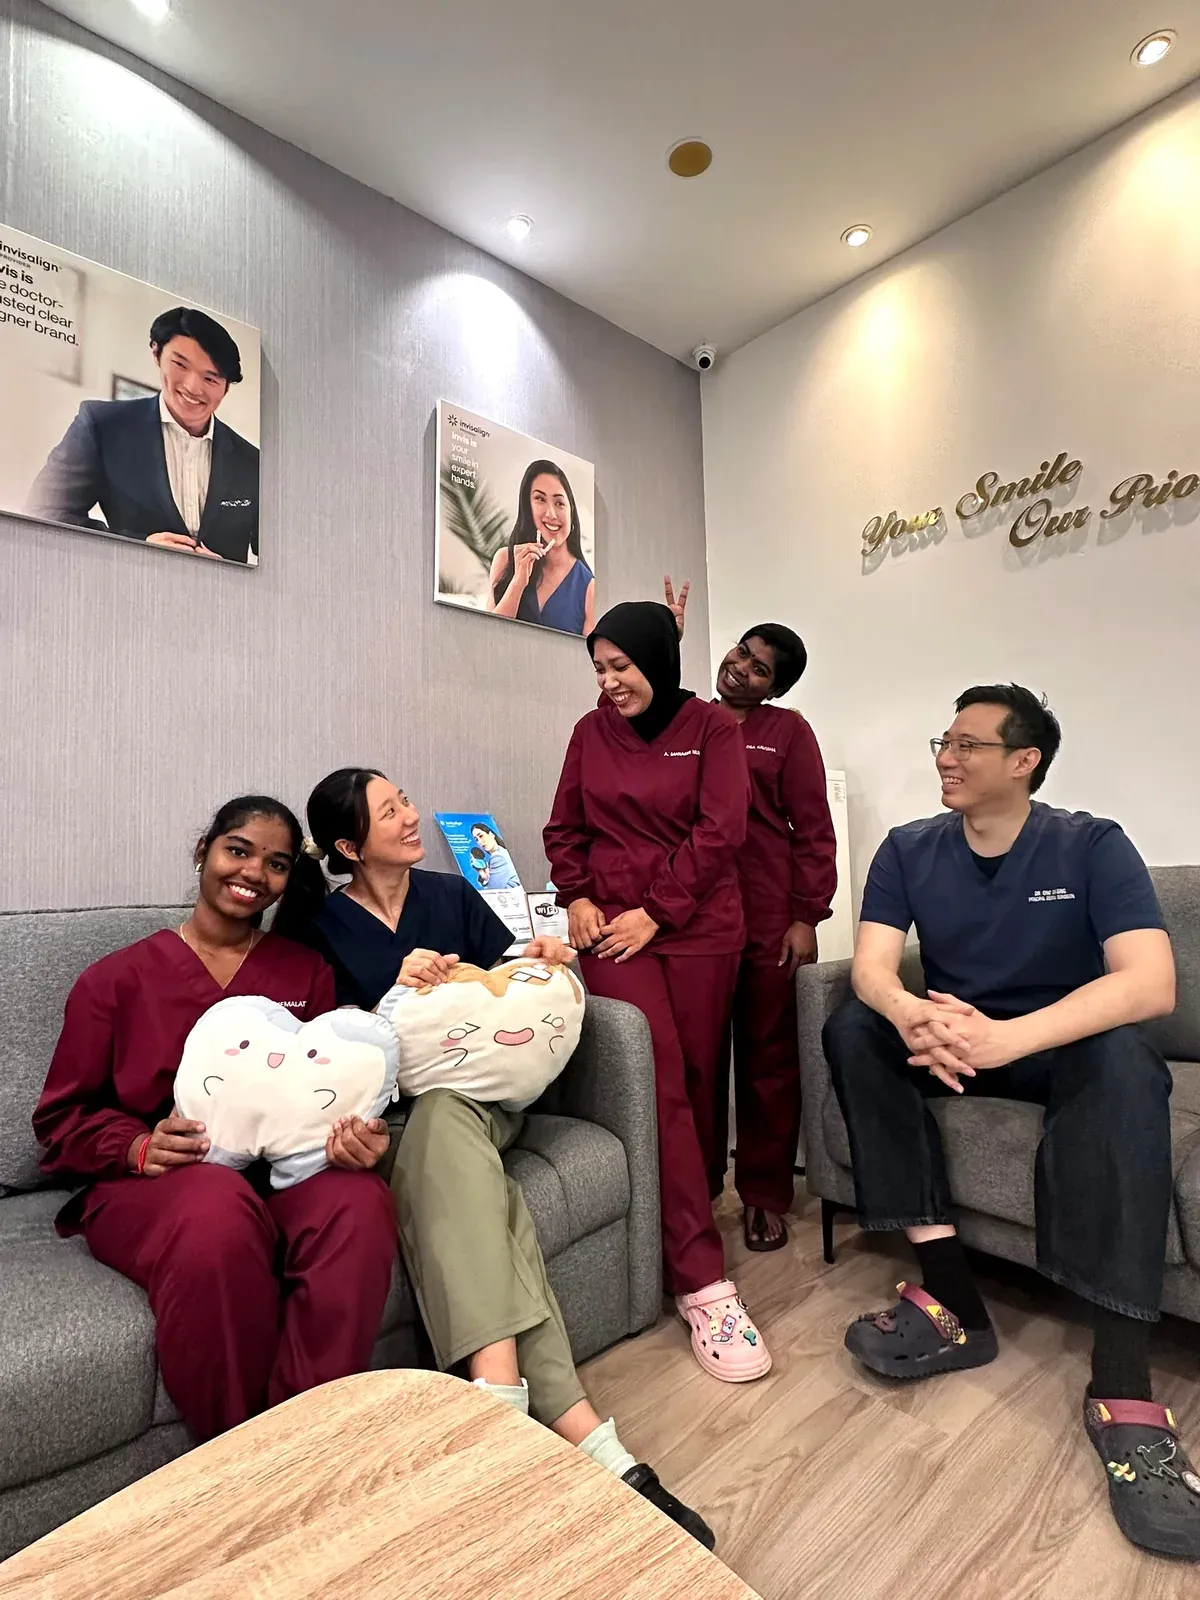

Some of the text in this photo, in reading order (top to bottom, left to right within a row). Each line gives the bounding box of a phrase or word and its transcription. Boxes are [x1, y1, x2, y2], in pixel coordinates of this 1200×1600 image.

[0, 241, 59, 273] invisalign
[21, 270, 34, 285] is
[9, 283, 64, 309] doctor-
[38, 309, 74, 329] clear
[34, 320, 79, 346] brand.
[460, 421, 490, 438] invisalign
[452, 444, 469, 455] your
[451, 464, 476, 479] expert
[451, 473, 476, 489] hands.
[861, 451, 1083, 557] Your Smile
[1008, 498, 1092, 548] Our
